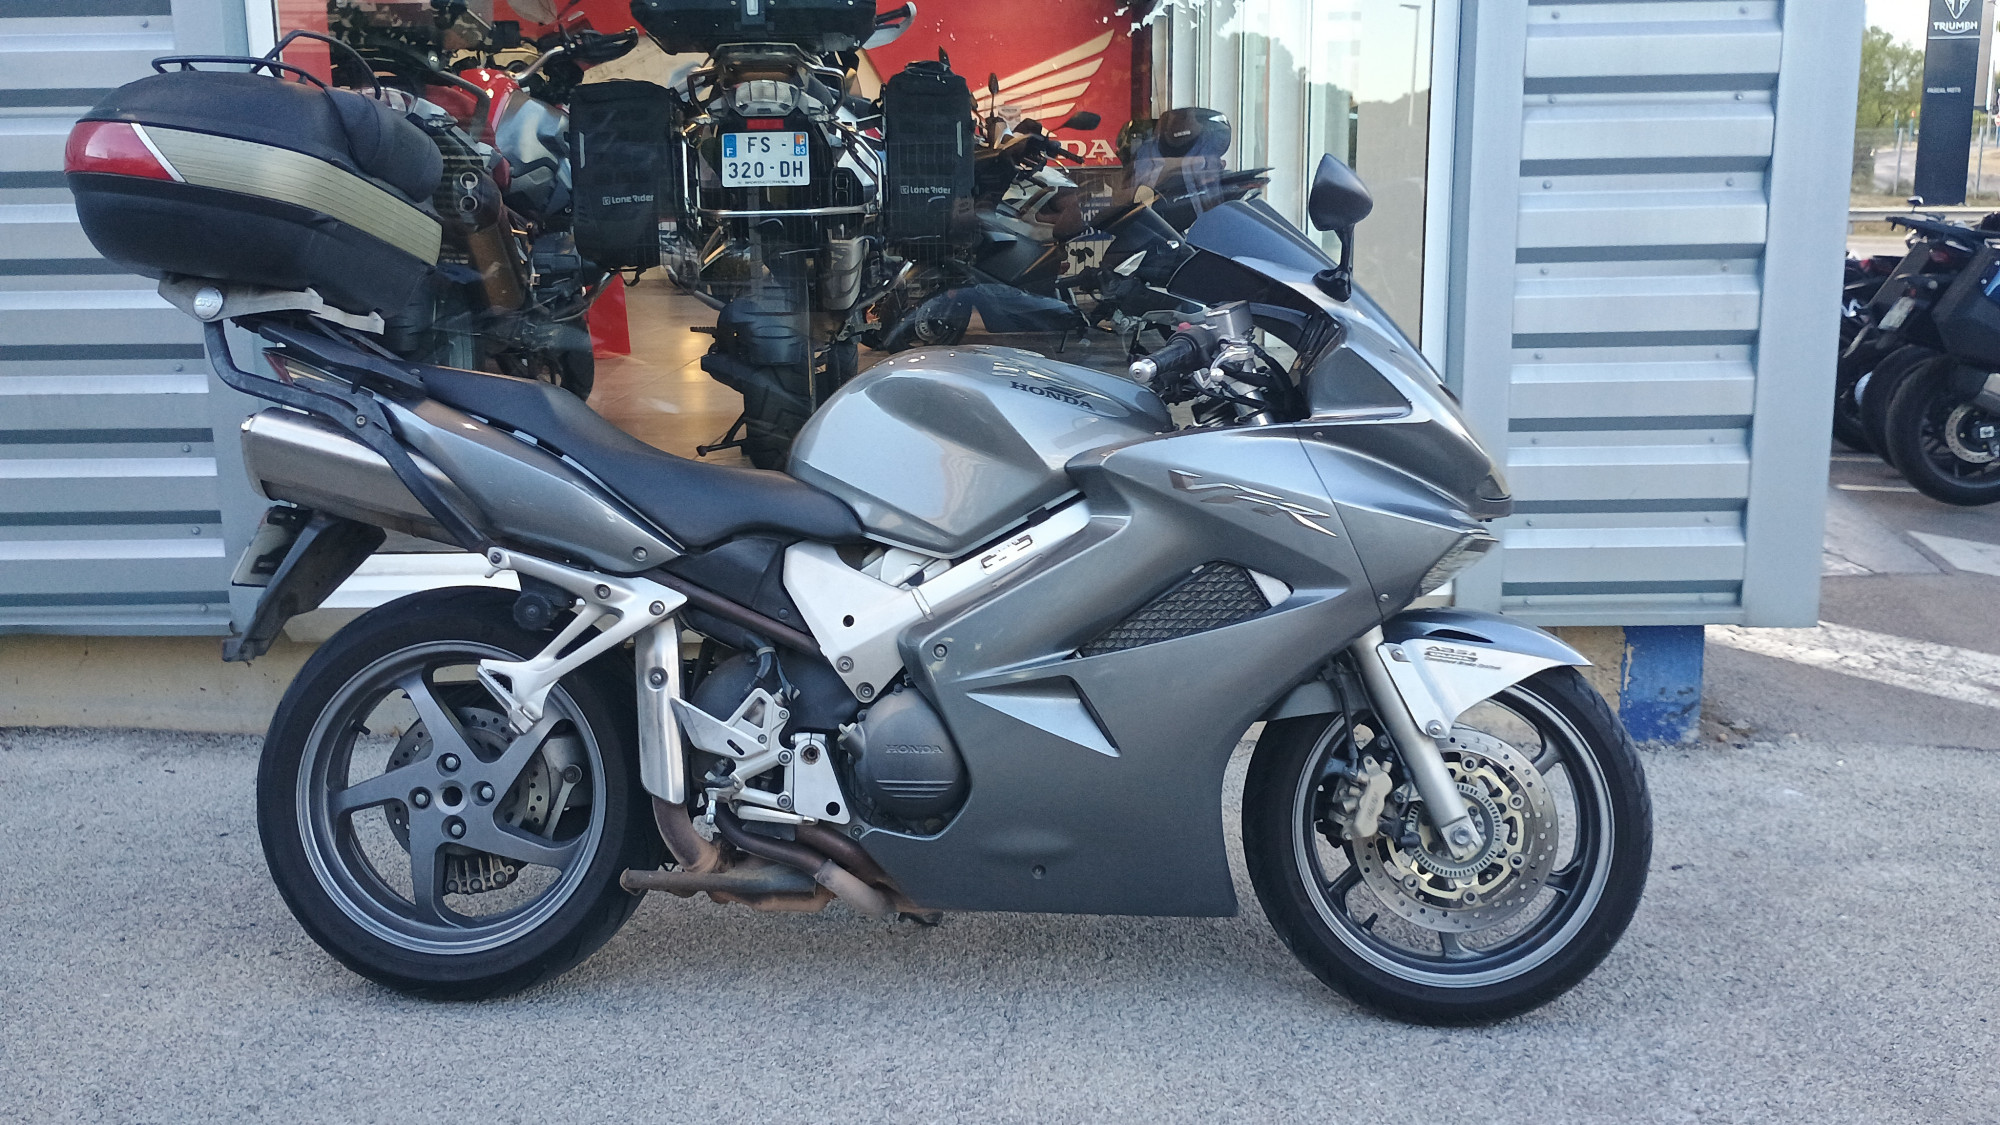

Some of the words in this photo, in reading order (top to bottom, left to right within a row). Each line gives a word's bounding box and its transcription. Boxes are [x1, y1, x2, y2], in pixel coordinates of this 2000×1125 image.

[1933, 21, 1978, 32] TRIUMPH
[747, 136, 771, 153] FS
[726, 147, 734, 157] F
[795, 146, 806, 155] 83
[1010, 380, 1095, 411] HONDA
[885, 744, 944, 755] HONDA
